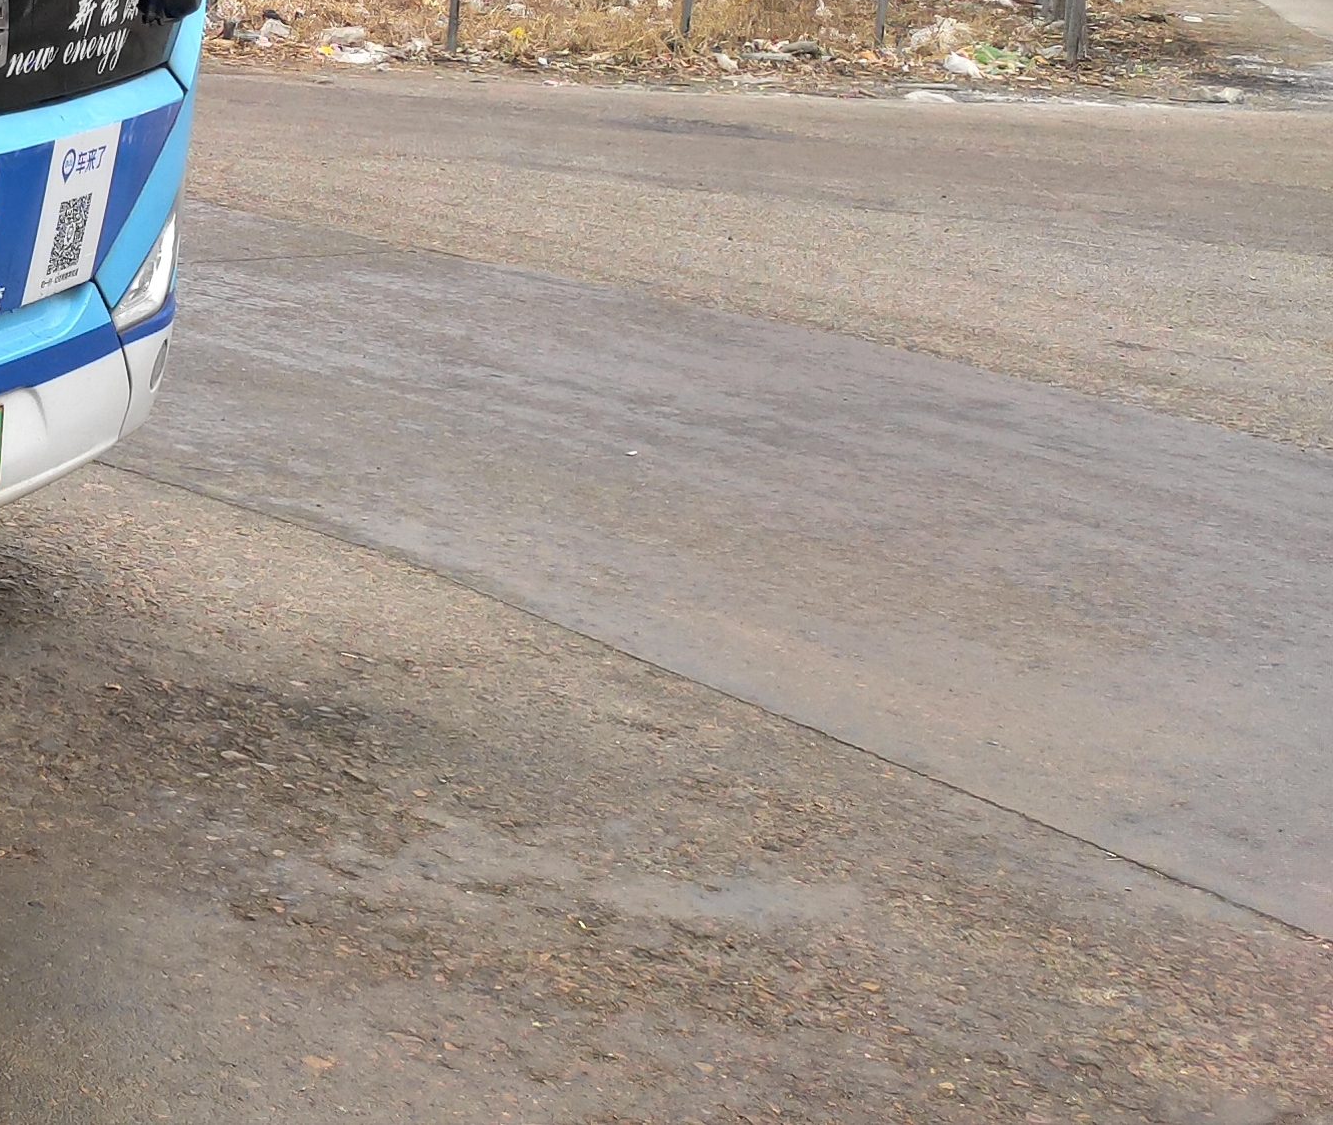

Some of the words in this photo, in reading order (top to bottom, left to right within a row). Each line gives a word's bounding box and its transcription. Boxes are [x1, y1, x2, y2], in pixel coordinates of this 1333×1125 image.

[5, 46, 59, 78] new
[62, 28, 131, 75] energy
[75, 145, 107, 175] 车来了
